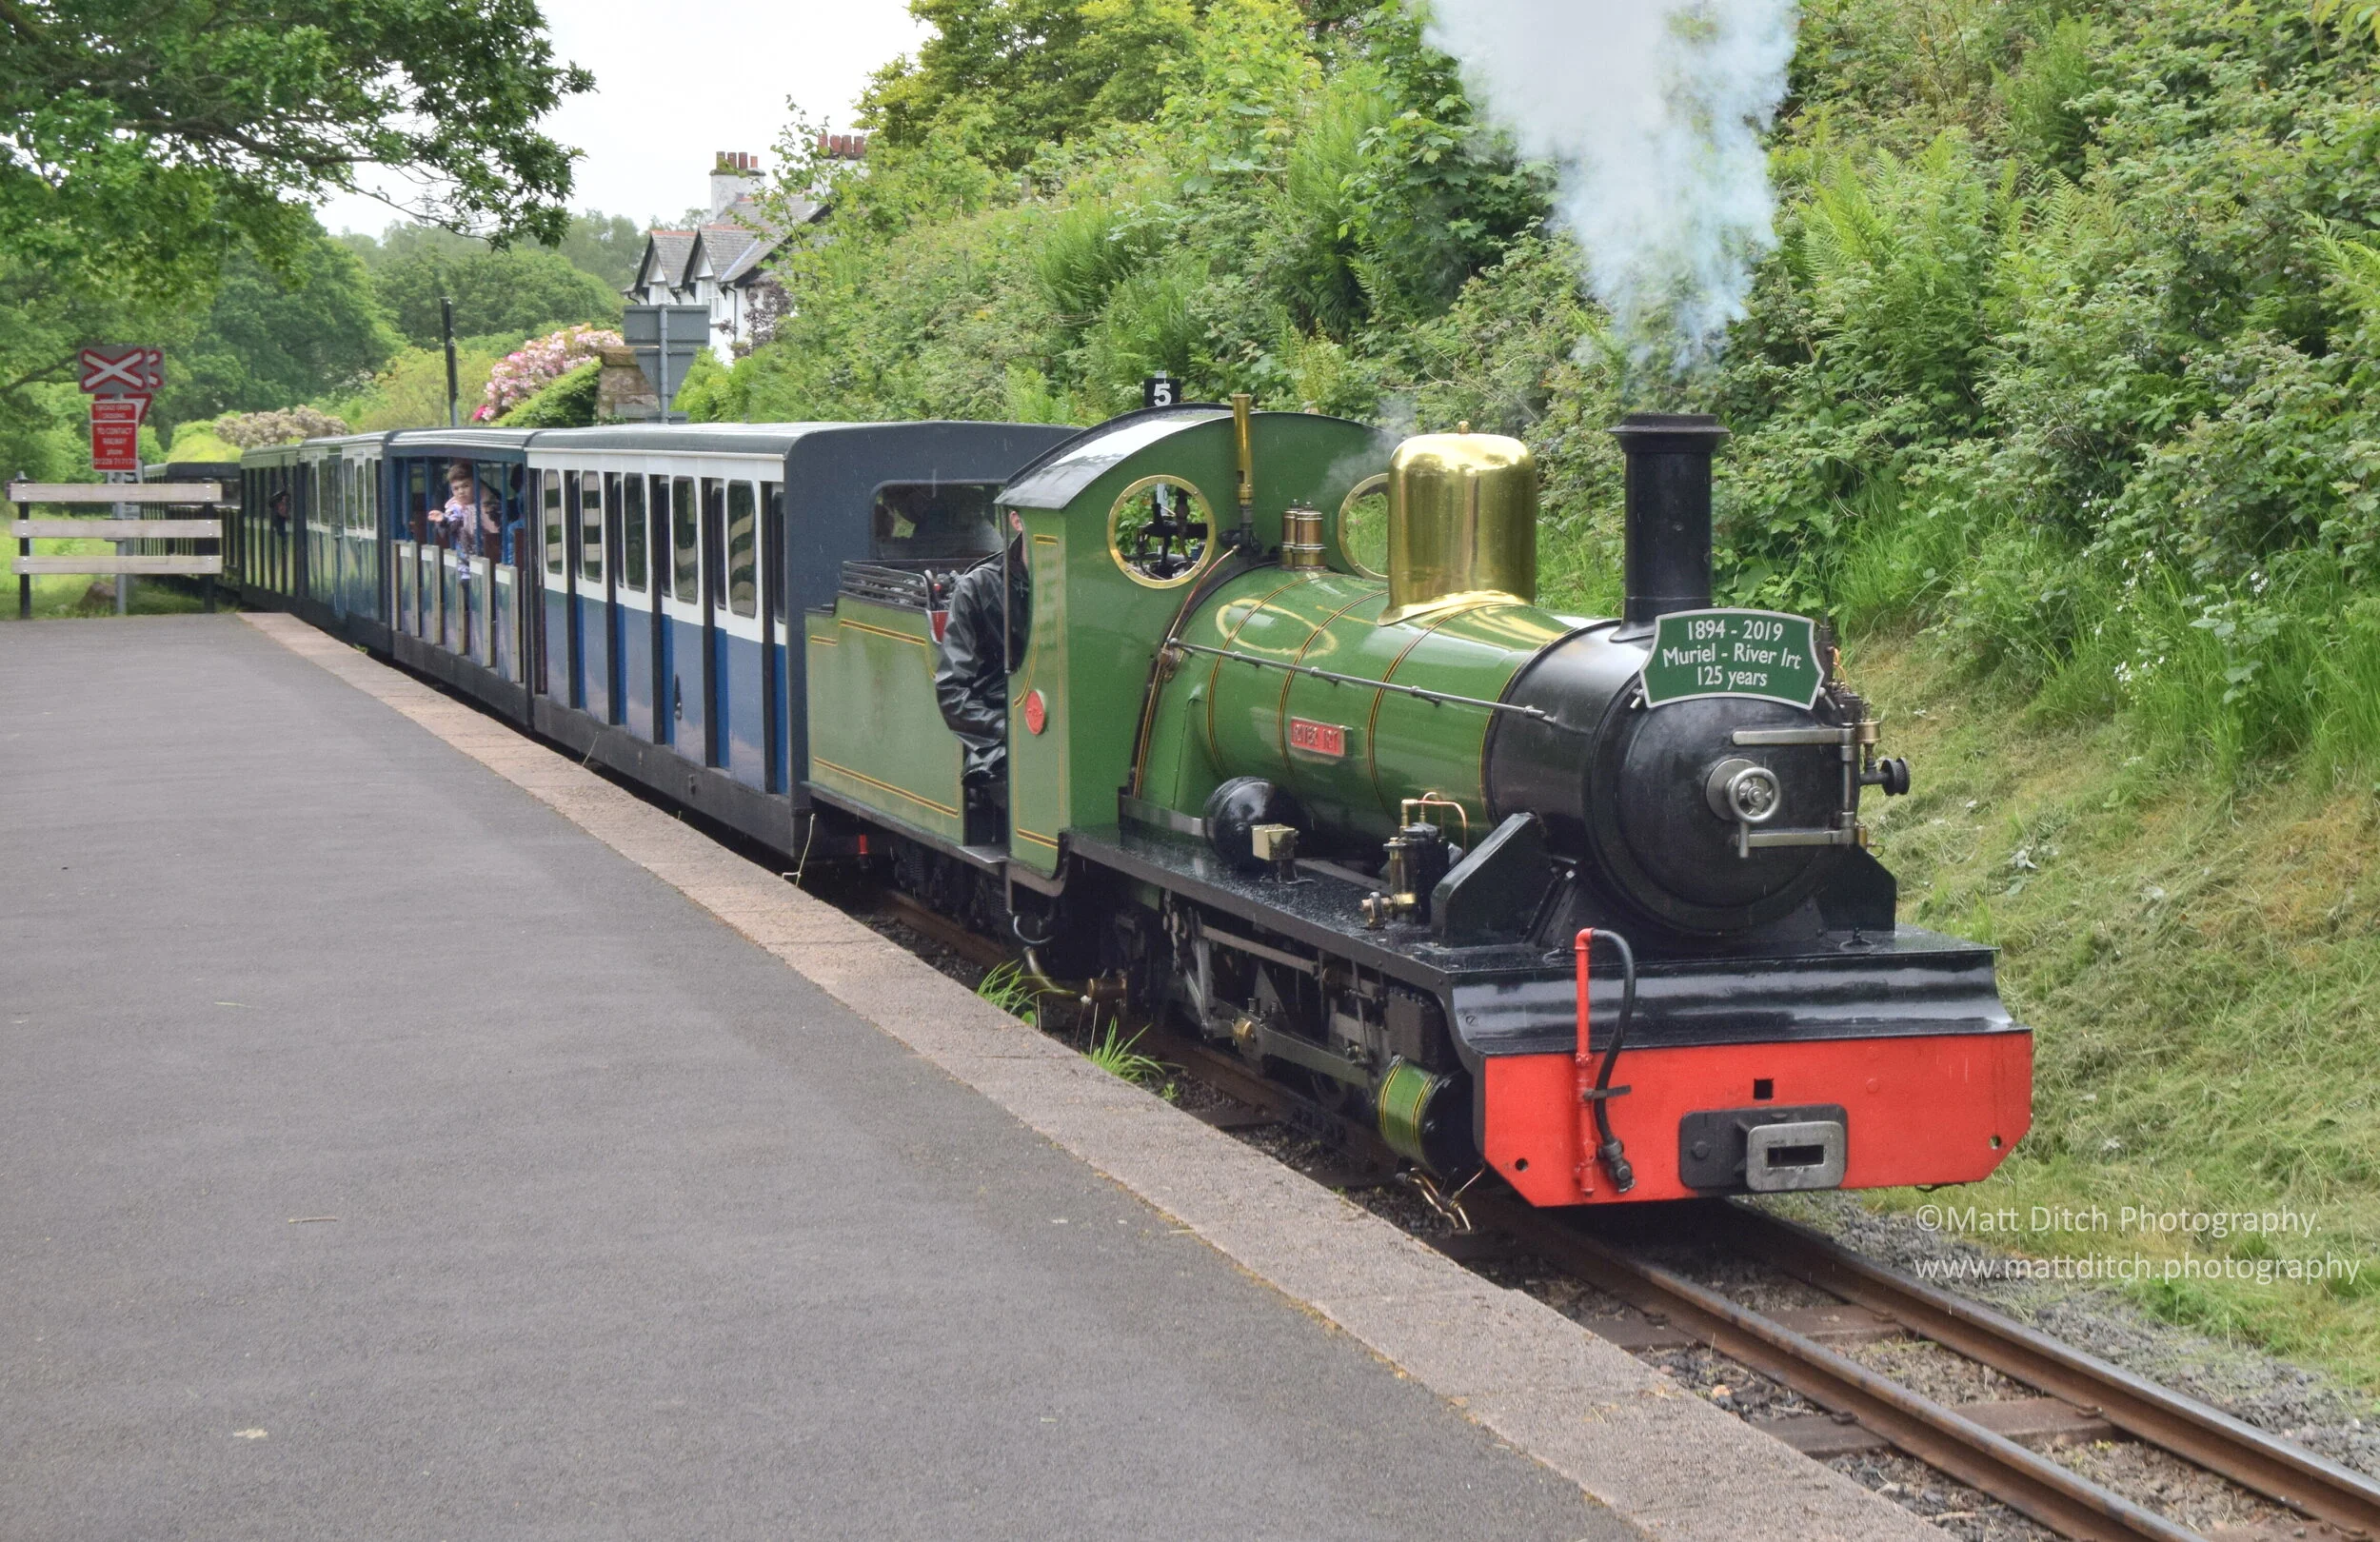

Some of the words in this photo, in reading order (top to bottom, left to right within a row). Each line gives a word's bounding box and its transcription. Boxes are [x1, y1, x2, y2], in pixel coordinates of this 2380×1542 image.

[1154, 384, 1171, 406] 5
[1688, 620, 1725, 640] 1894
[1743, 620, 1783, 642] 2019
[1663, 643, 1716, 667] Muriel
[1734, 642, 1776, 664] River
[1780, 647, 1801, 669] Irt
[1697, 666, 1722, 685] 125
[1728, 670, 1767, 690] years
